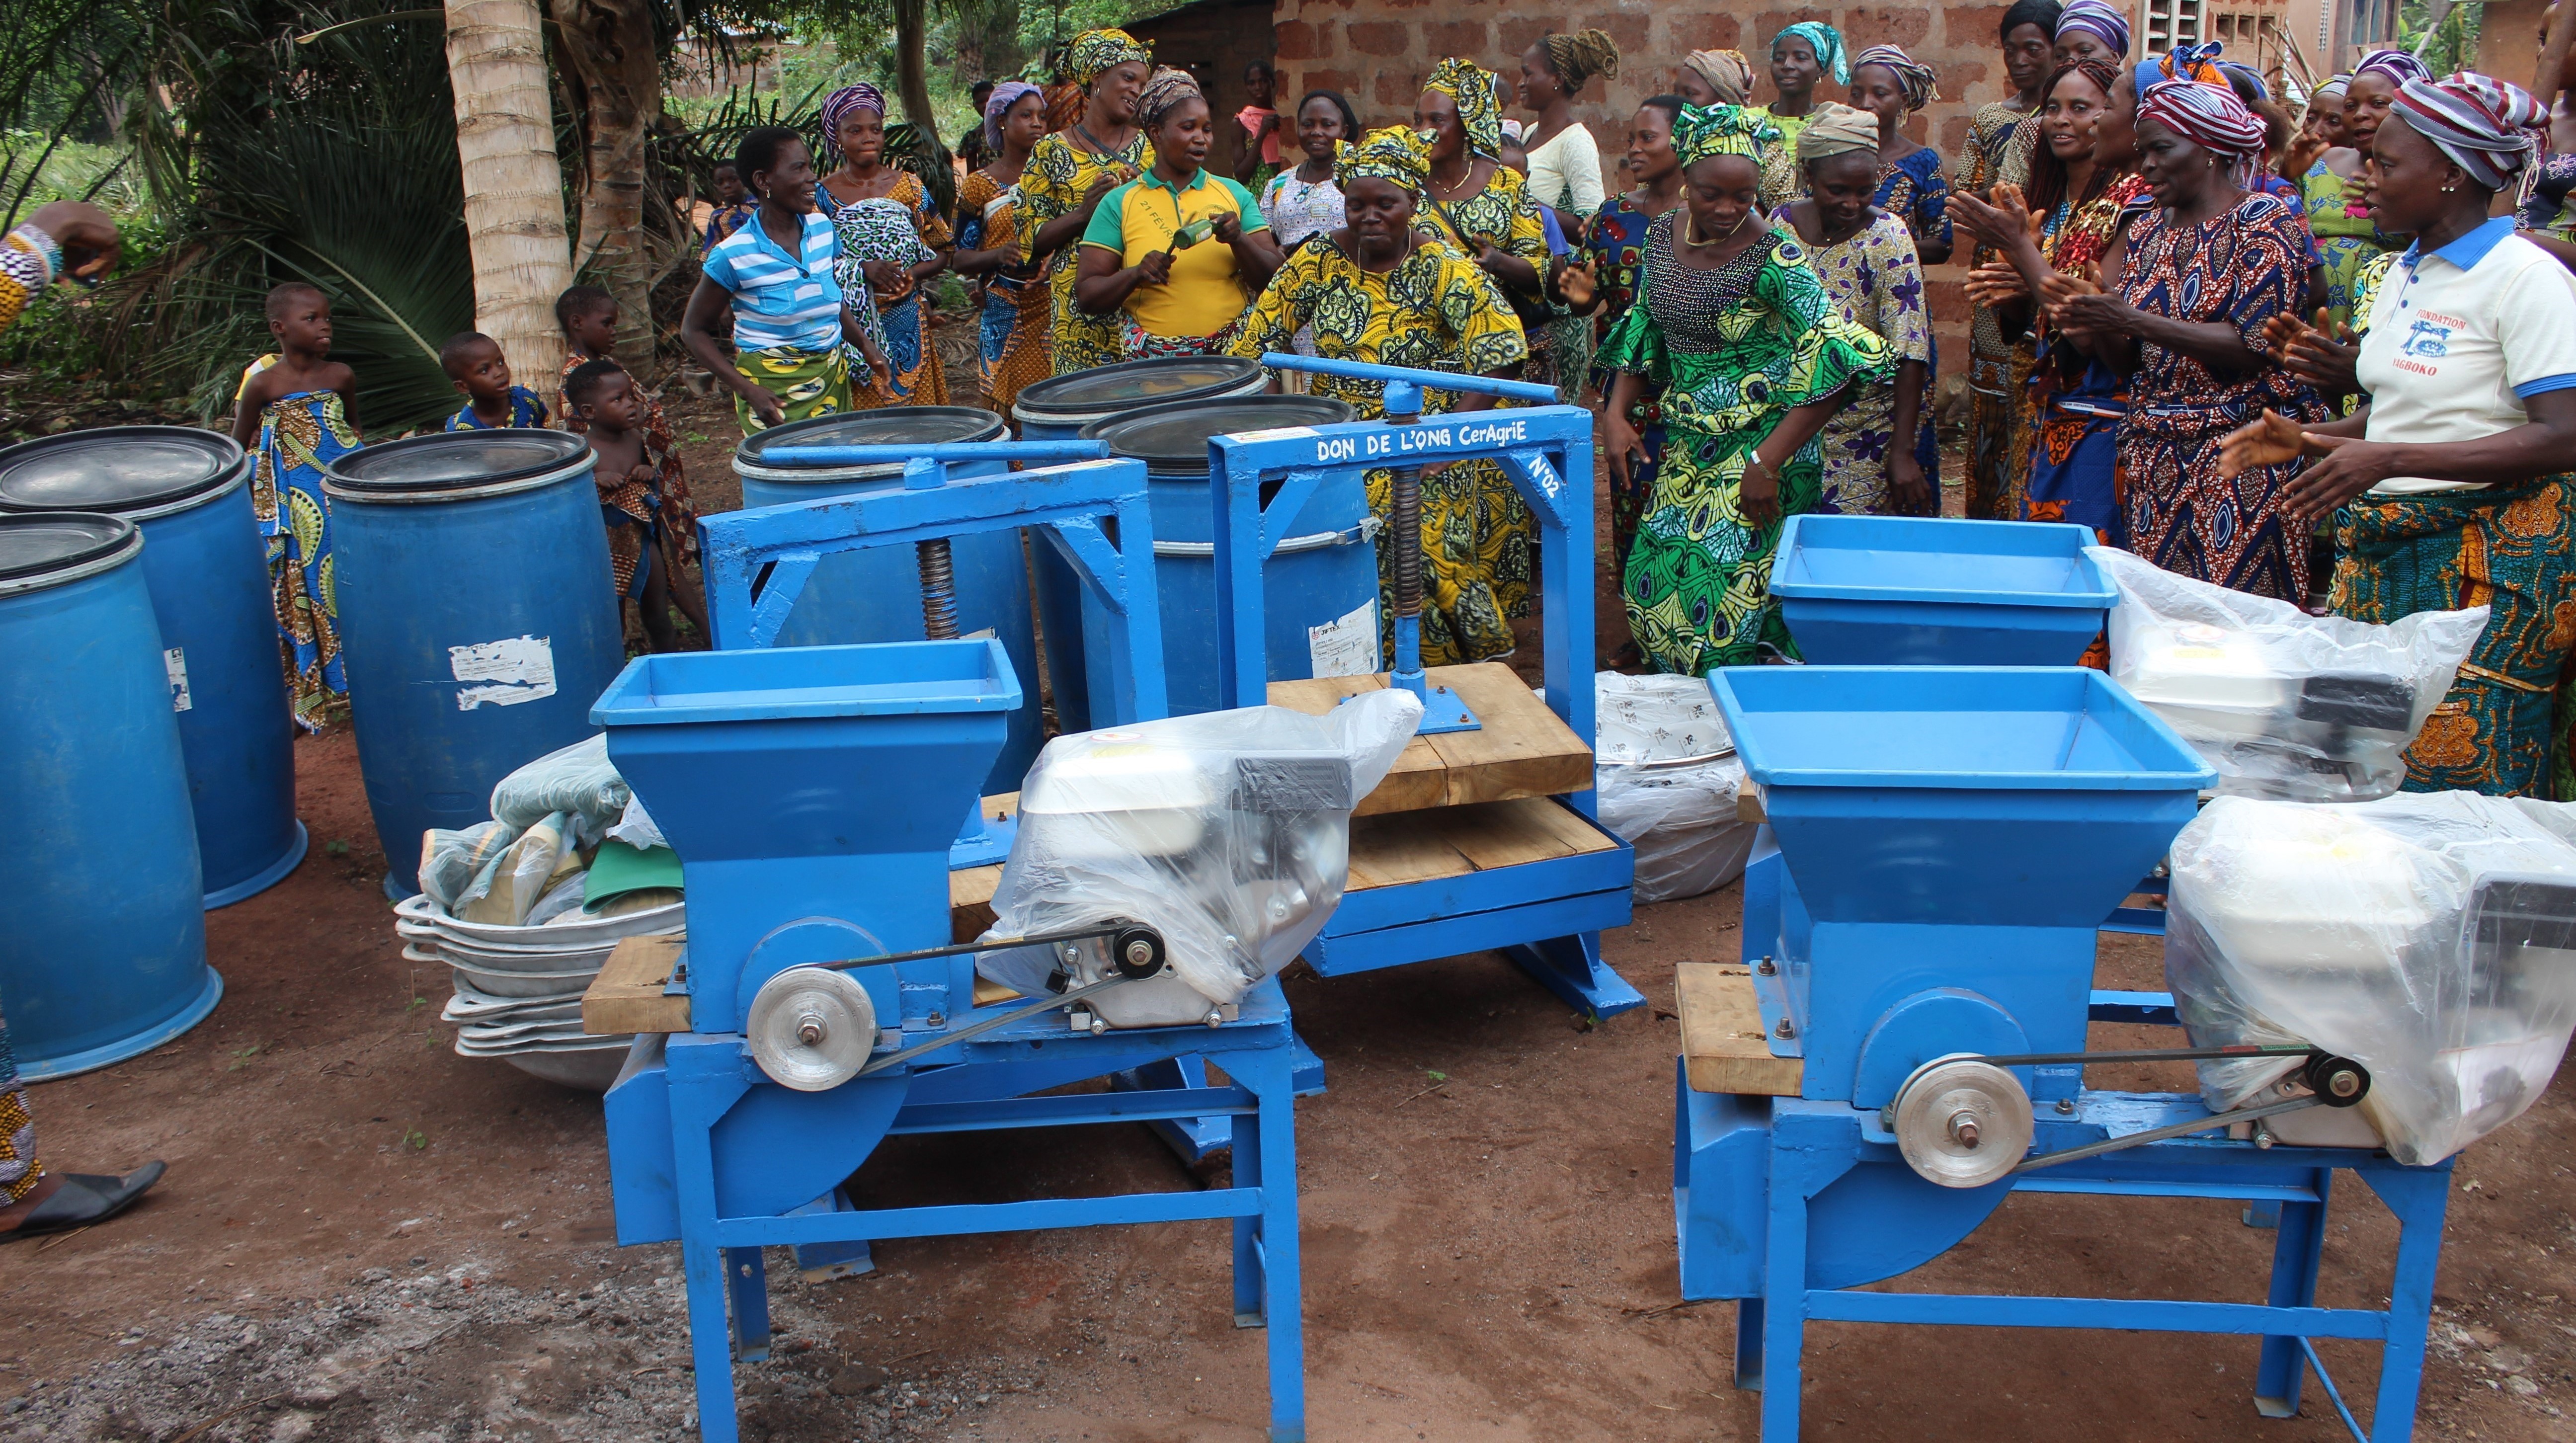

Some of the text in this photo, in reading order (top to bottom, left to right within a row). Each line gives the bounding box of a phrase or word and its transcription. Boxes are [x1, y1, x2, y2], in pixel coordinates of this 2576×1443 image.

[1140, 201, 1175, 245] 21 FÉVRI
[2416, 309, 2467, 330] FONDATION
[2392, 357, 2437, 377] YAGBOKO
[1318, 421, 1527, 461] DON DE L'ONG CerAgriE
[1321, 624, 1340, 635] JIFTEX
